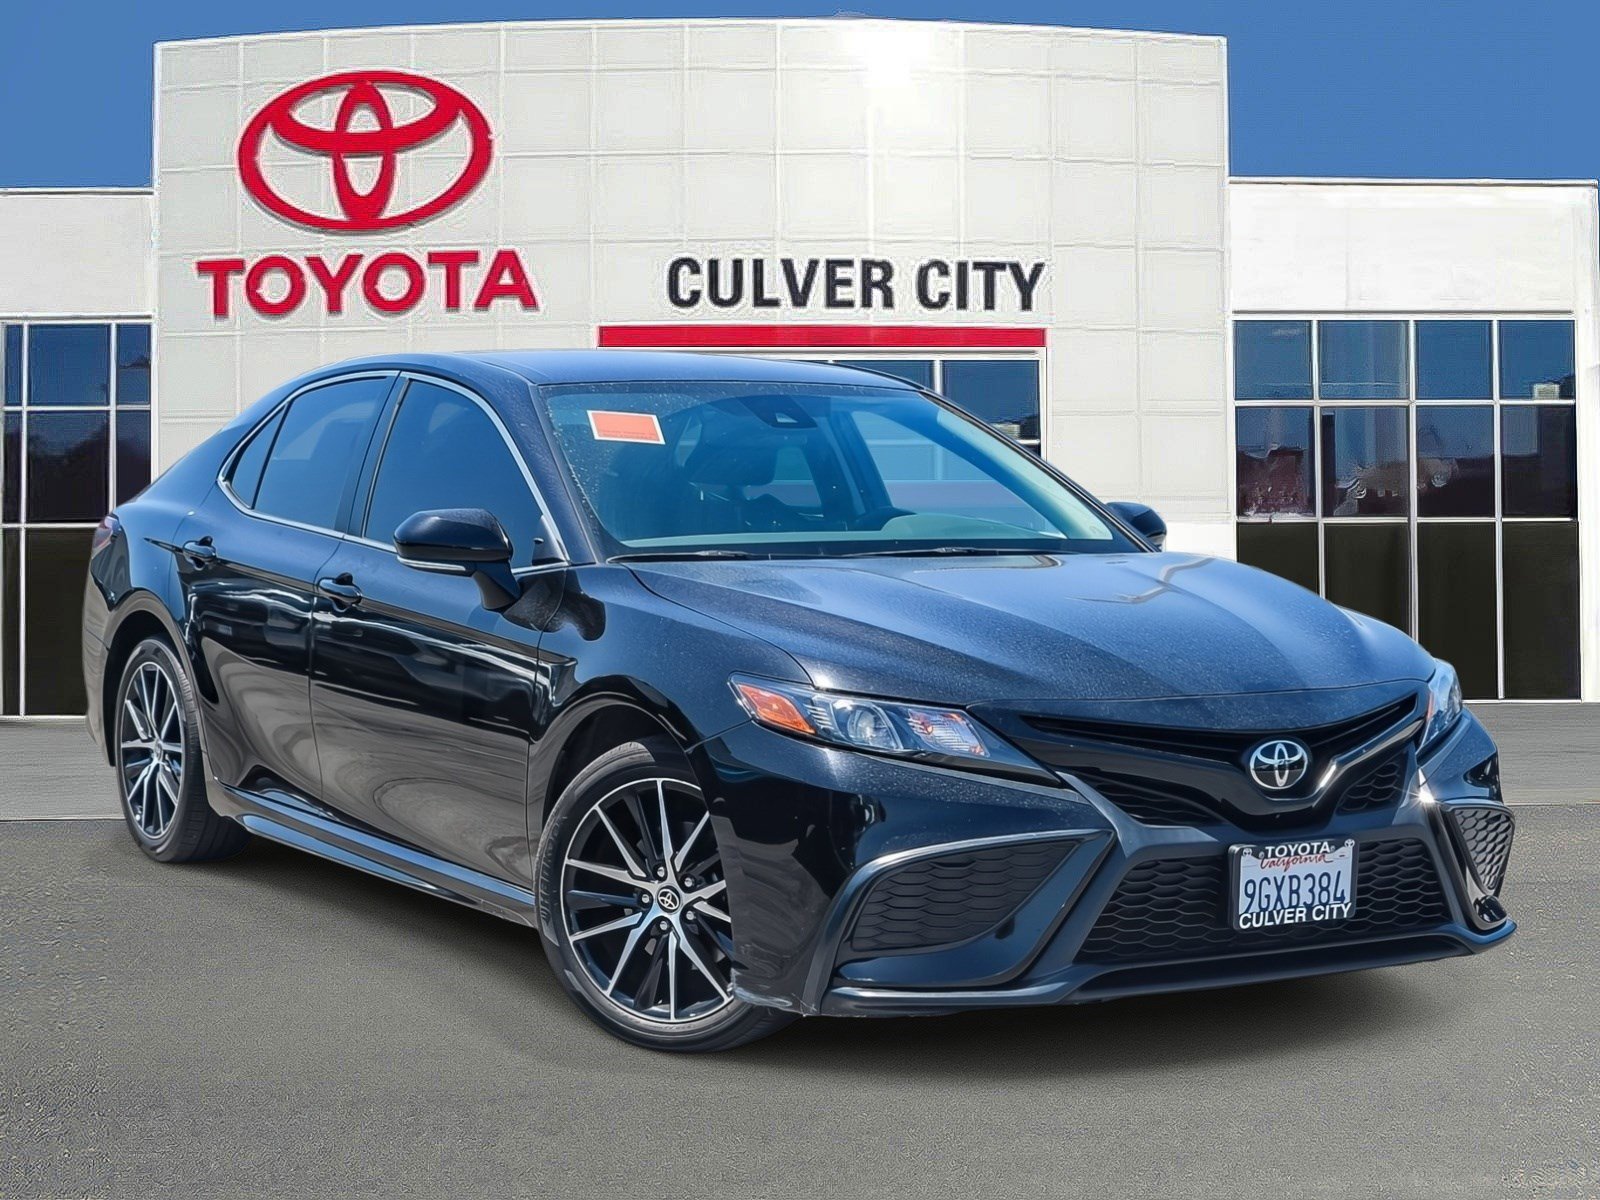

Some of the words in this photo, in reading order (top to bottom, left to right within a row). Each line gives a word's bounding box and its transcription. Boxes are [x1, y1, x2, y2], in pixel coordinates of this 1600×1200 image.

[195, 249, 539, 319] TOYOTA
[667, 257, 895, 309] CULVER
[915, 258, 1046, 312] CITY
[1259, 854, 1333, 872] California
[1265, 841, 1331, 858] TOYOTA
[1243, 870, 1346, 914] 9GXB384
[1239, 907, 1306, 929] CULVER
[1311, 902, 1352, 921] CITY
